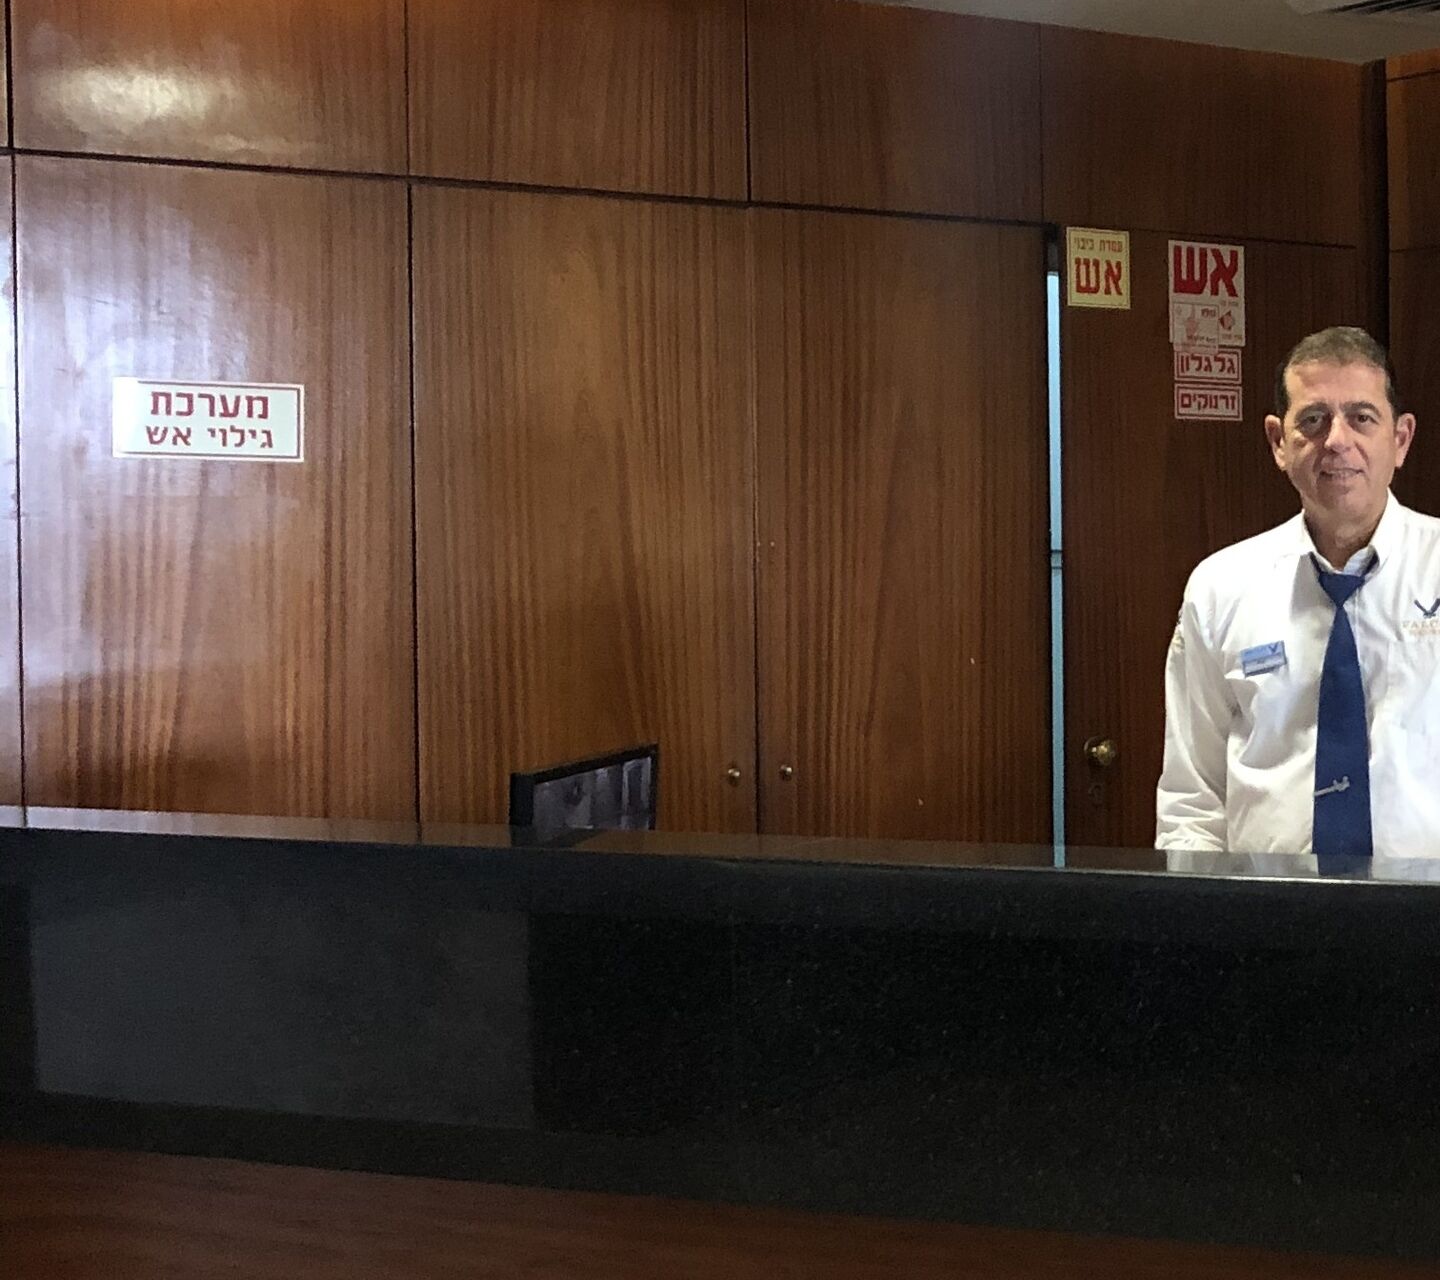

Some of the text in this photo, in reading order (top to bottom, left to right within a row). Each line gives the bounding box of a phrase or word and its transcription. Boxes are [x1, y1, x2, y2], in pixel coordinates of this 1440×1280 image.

[1074, 256, 1123, 296] אש
[1174, 244, 1239, 298] אש
[1180, 352, 1236, 374] גלגלון
[150, 391, 269, 420] מערכת
[1180, 393, 1236, 411] זרנוקים
[146, 425, 273, 449] גילוי אש
